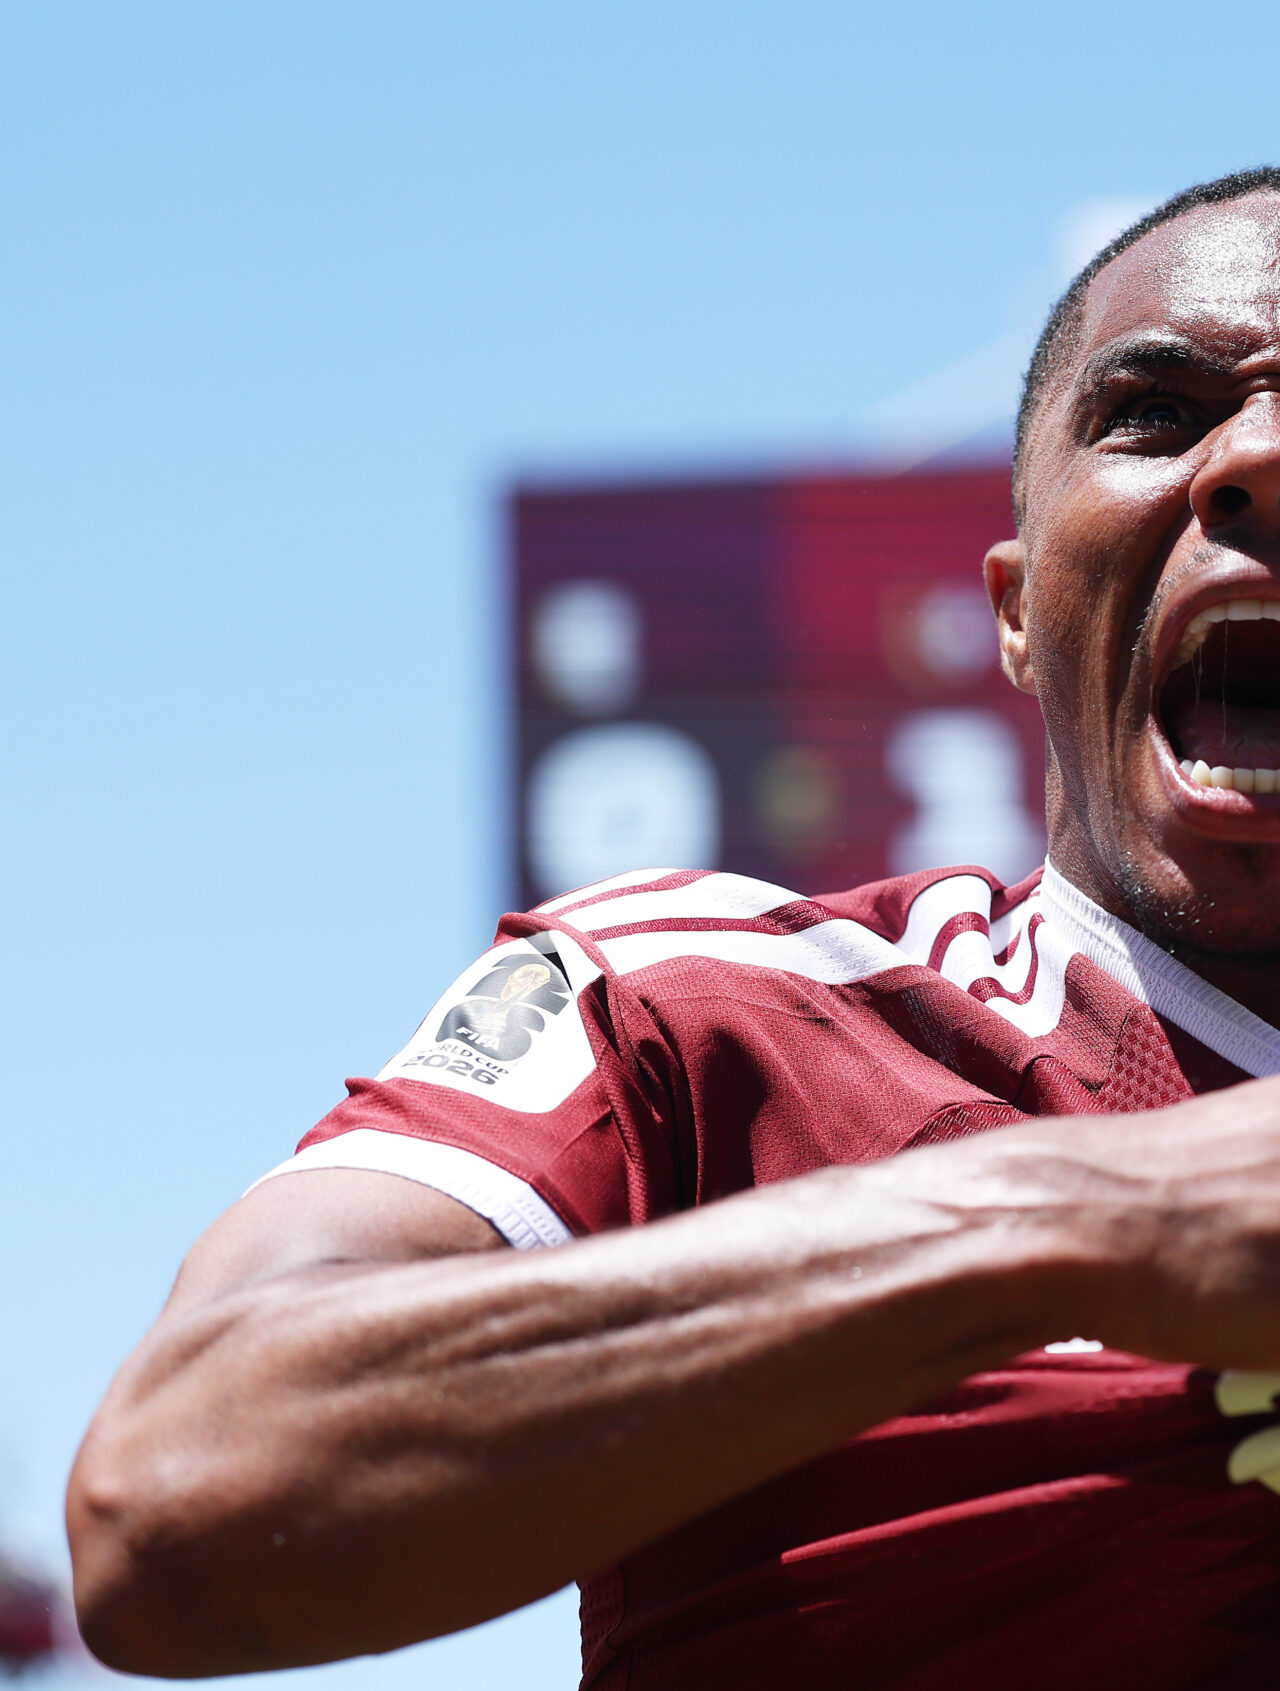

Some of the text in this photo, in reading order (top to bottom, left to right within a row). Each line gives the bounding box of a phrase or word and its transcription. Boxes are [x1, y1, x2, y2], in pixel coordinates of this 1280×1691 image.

[456, 1026, 501, 1051] FIFA
[400, 1053, 500, 1085] 2026
[474, 1056, 509, 1074] CUP
